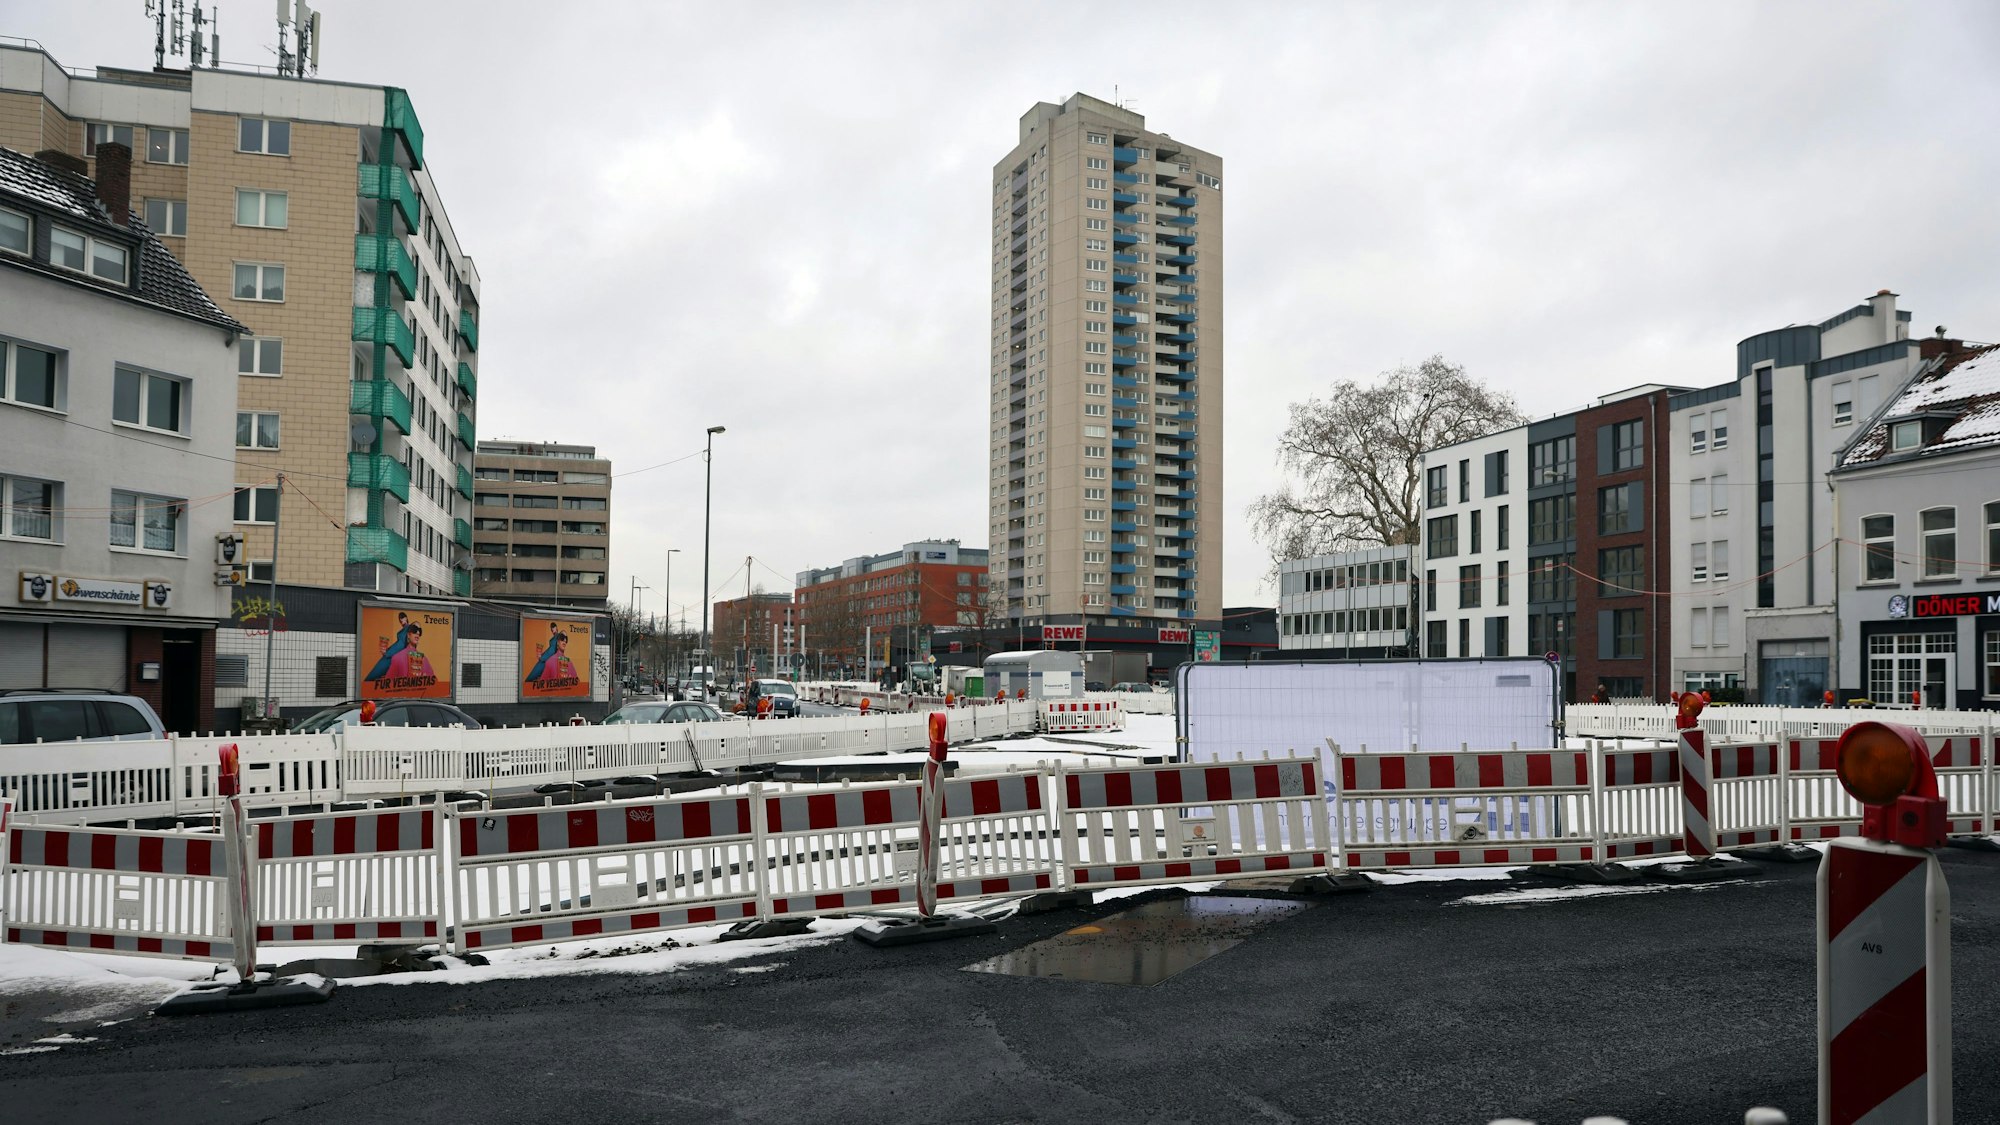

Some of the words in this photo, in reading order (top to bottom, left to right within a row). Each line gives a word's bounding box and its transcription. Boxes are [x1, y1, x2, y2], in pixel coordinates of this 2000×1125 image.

[1917, 594, 1980, 616] DÖNER
[424, 614, 449, 625] Treets
[570, 624, 589, 634] Treets
[1044, 627, 1084, 639] REWE
[393, 674, 436, 688] VEGANISTAS
[1861, 941, 1883, 954] AVS
